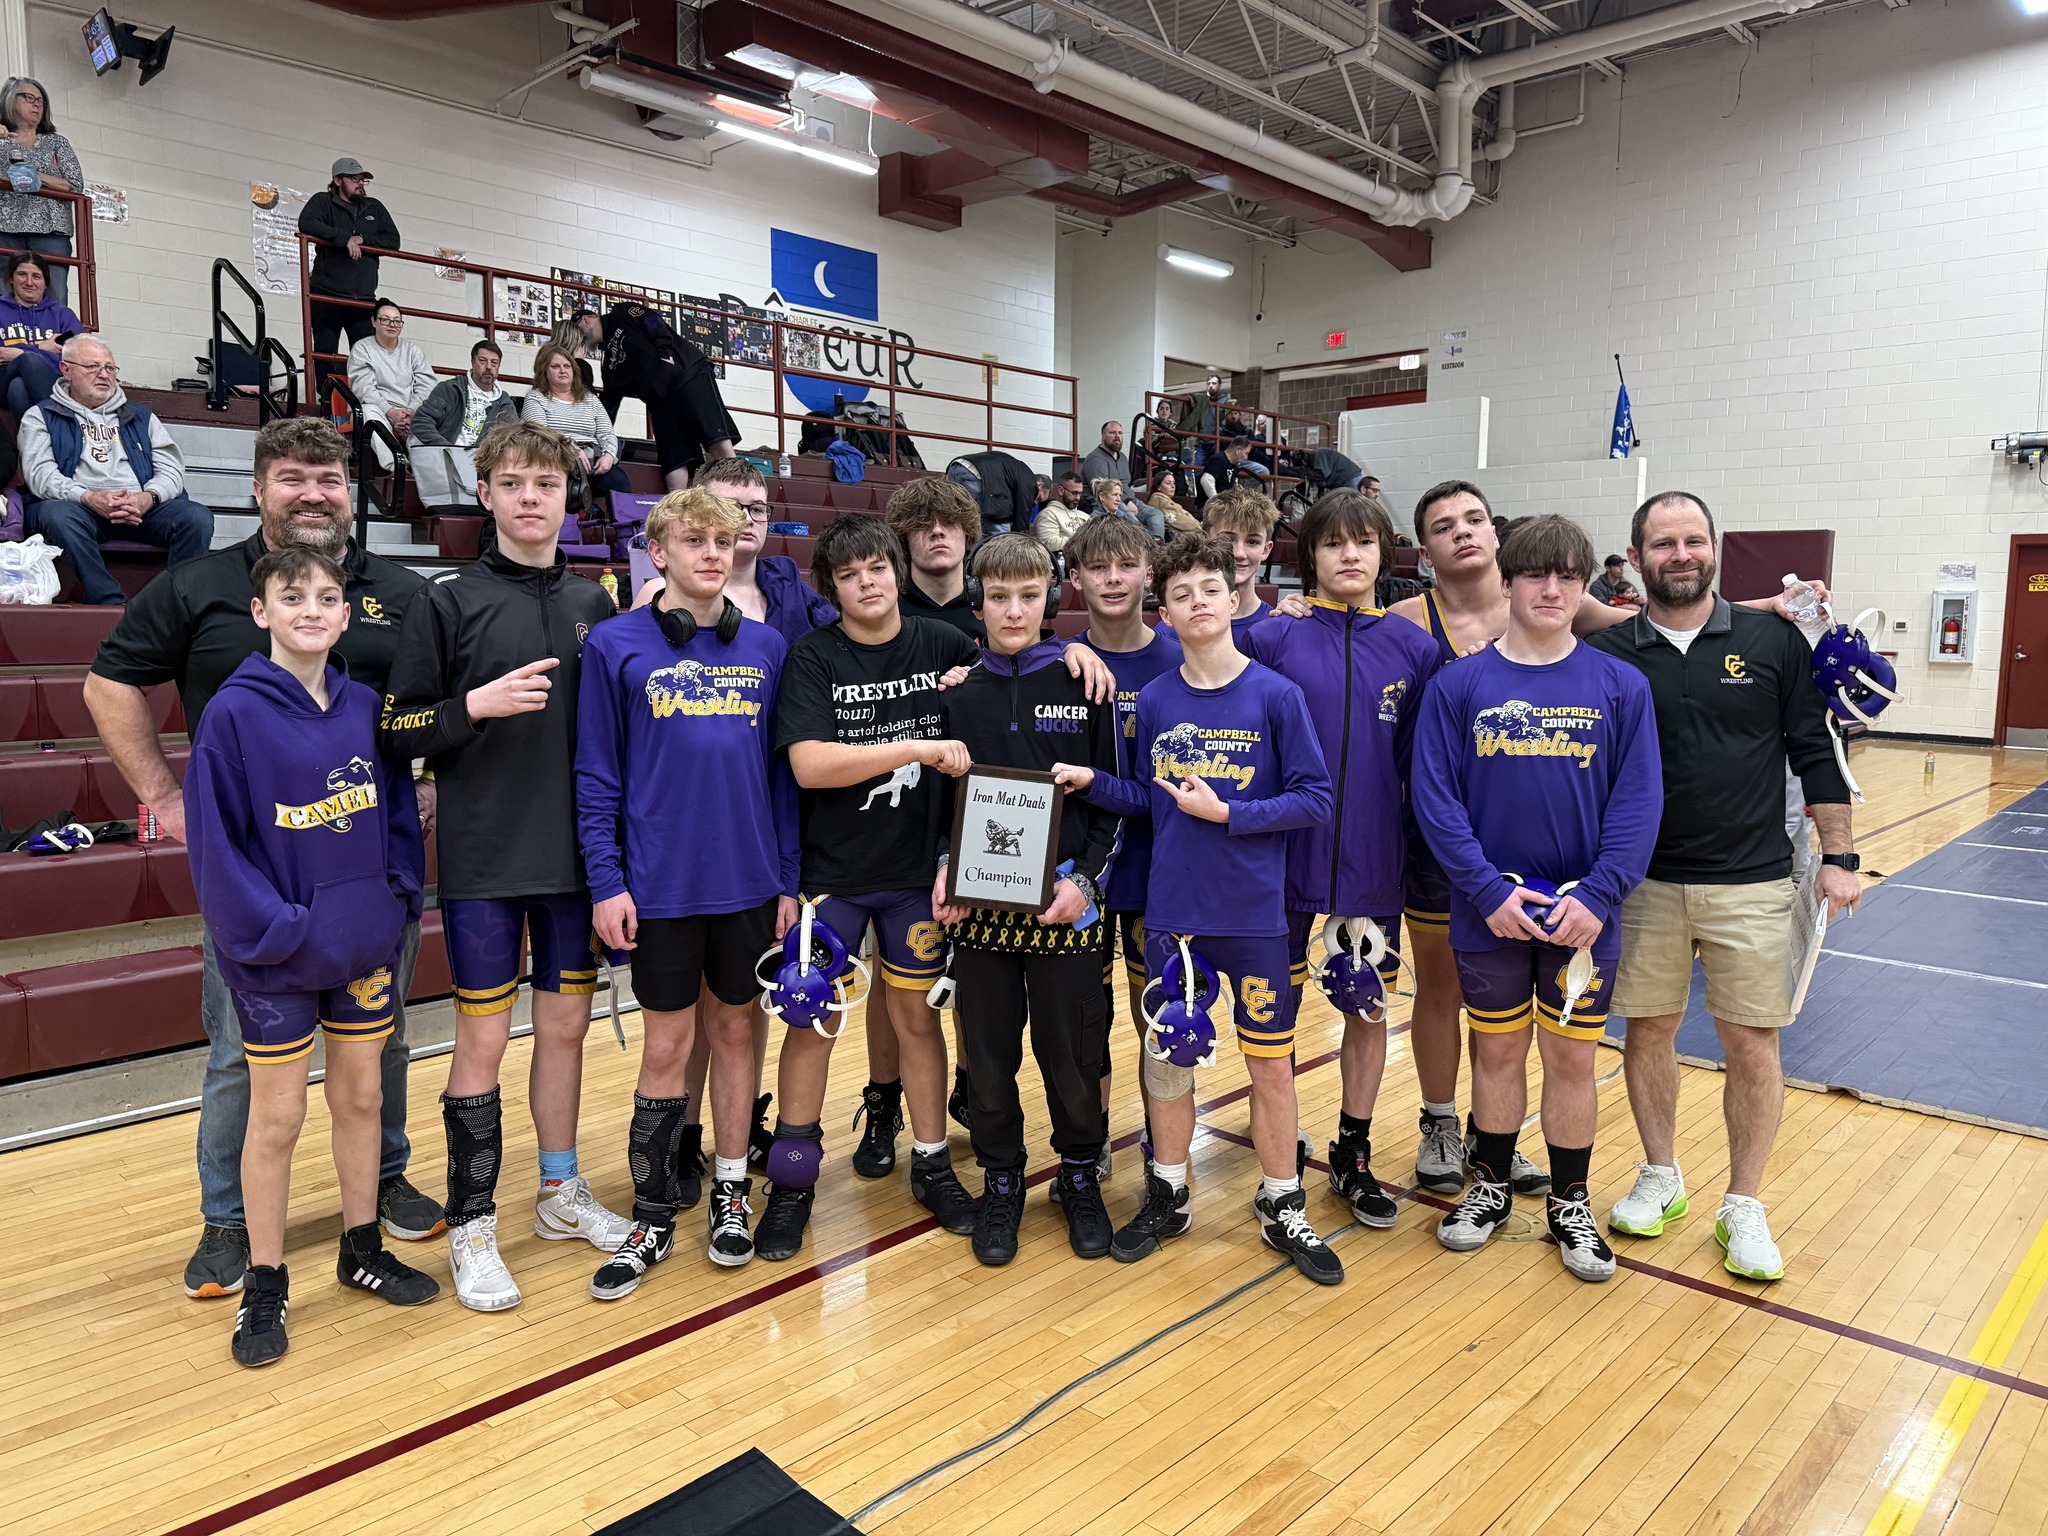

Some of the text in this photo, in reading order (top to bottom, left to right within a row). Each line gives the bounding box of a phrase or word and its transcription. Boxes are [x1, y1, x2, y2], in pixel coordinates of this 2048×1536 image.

[789, 314, 819, 329] CHARLEE
[1402, 356, 1417, 368] EXIT
[1441, 361, 1465, 370] RESTROOM
[362, 596, 384, 619] CC
[359, 616, 391, 626] WRESTLING
[704, 666, 766, 679] CAMPBELL
[1724, 654, 1746, 679] CC
[714, 677, 761, 689] COUNTY
[832, 671, 940, 704] WRESTLIN
[651, 689, 761, 727] Wrestling
[1034, 704, 1088, 720] CANCER
[1532, 706, 1603, 719] CAMPBELL
[847, 728, 864, 737] art
[865, 724, 875, 736] of
[1034, 719, 1084, 734] SUCKS.
[1541, 718, 1595, 730] COUNTY
[912, 730, 924, 739] in
[1197, 729, 1261, 742] CAMPBELL
[1204, 741, 1253, 753] COUNTY
[1476, 730, 1598, 769] Wrestling
[1155, 753, 1256, 791] Wrestling
[972, 788, 1046, 810] Iron Mat Duals
[965, 866, 1032, 888] Champion
[906, 920, 945, 962] CC
[1241, 975, 1276, 1023] CC
